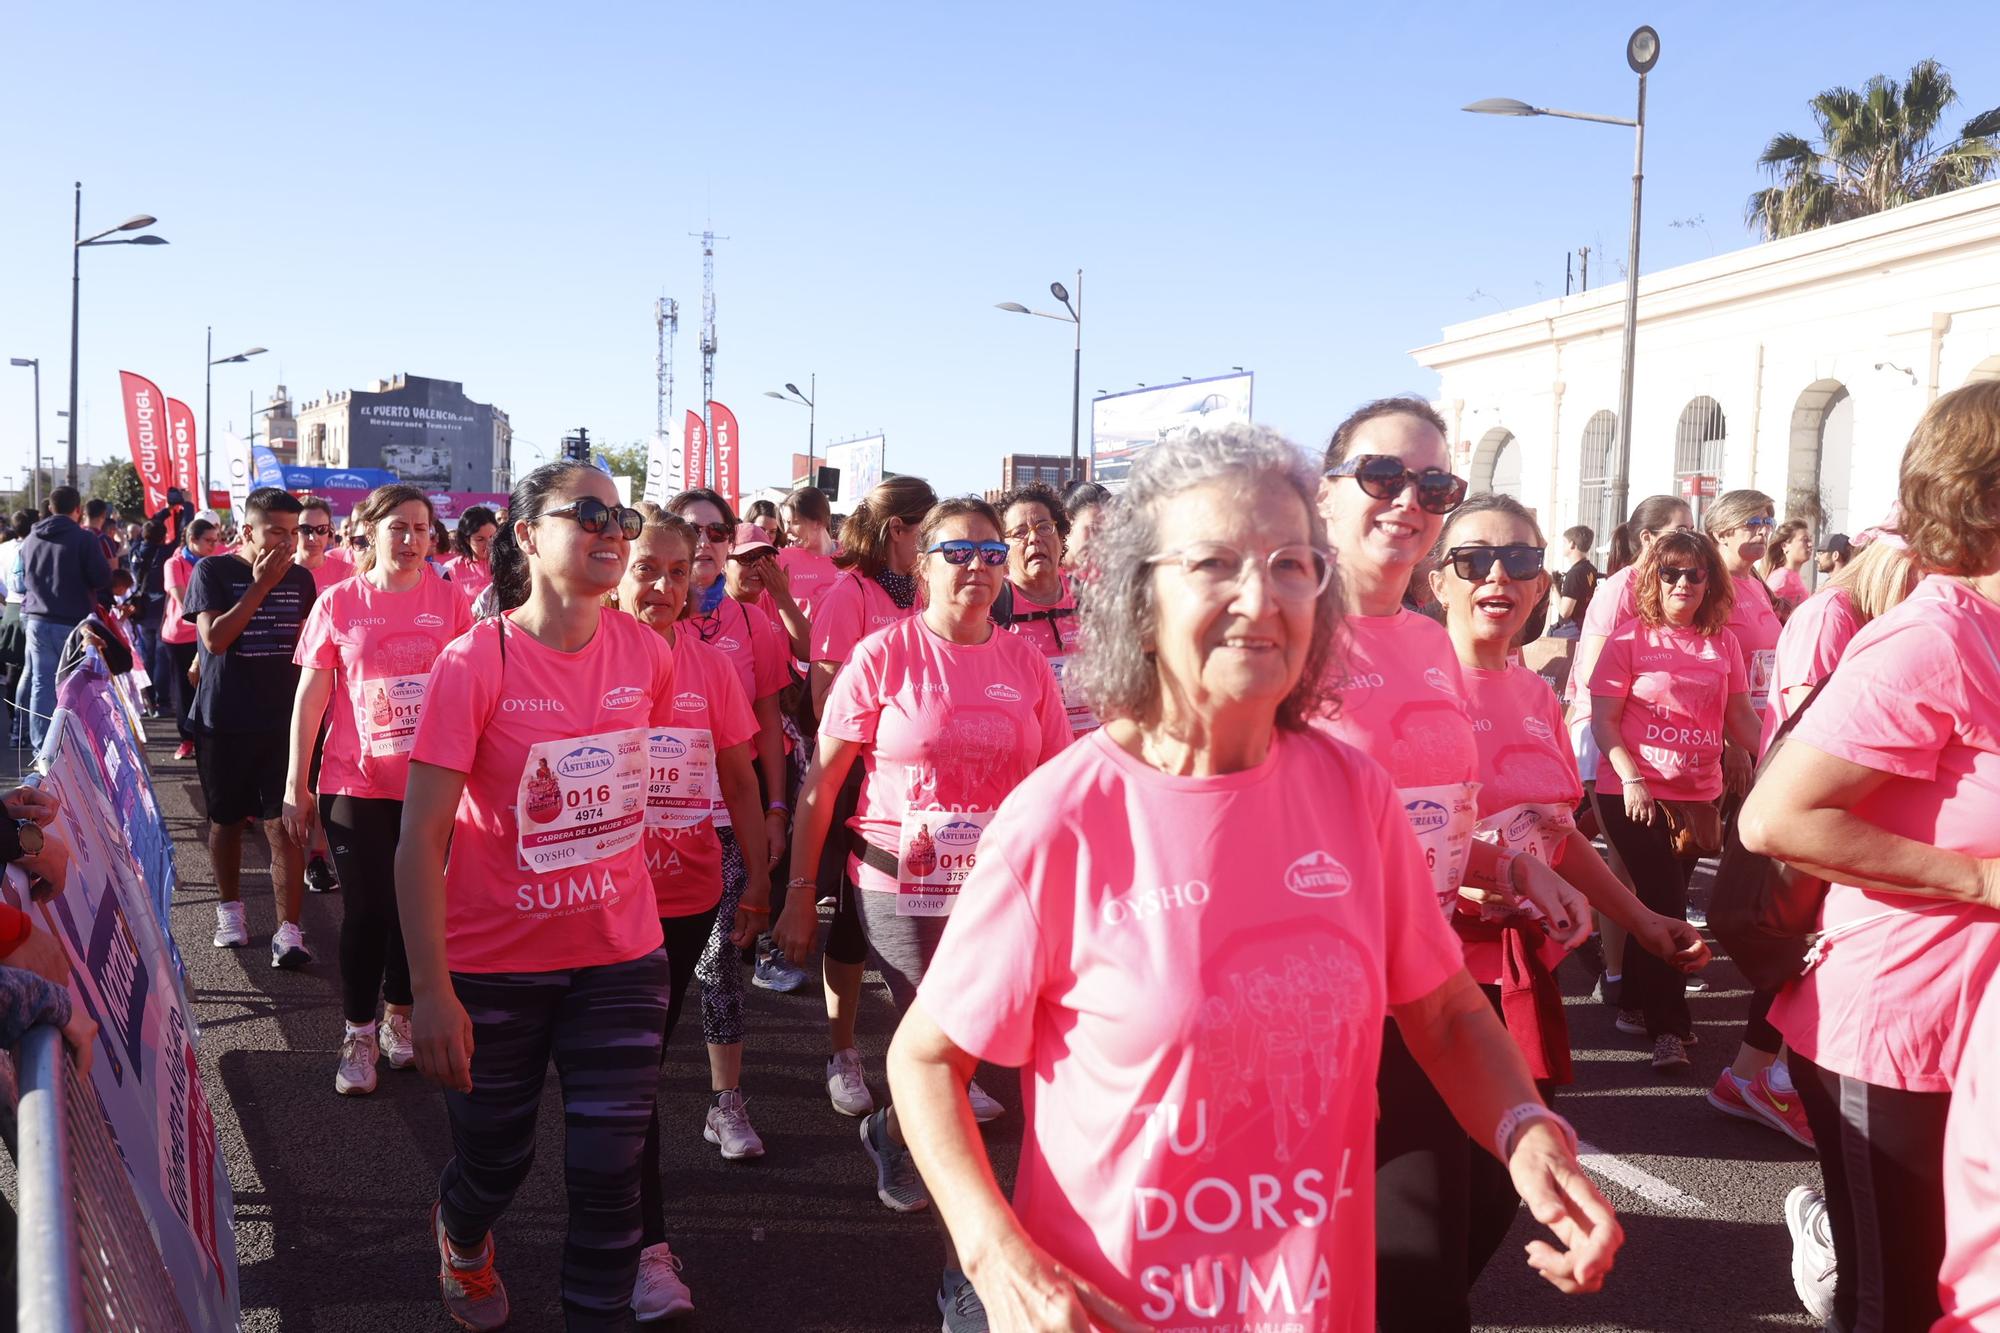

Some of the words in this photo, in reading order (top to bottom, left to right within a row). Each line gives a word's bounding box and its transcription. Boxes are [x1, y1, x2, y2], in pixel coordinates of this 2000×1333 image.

[361, 407, 371, 415] EL
[373, 406, 410, 418] PUERTO
[349, 617, 386, 626] OYSHO
[502, 699, 565, 712] OYSHO
[1646, 724, 1719, 746] DORSAL
[618, 745, 641, 755] SUMA
[649, 745, 683, 754] STURIANA
[1643, 746, 1699, 769] SUMA
[562, 758, 611, 773] ASTURIANA
[904, 765, 937, 791] TU
[566, 785, 611, 808] 016
[648, 784, 671, 794] 4975
[575, 807, 603, 822] 4974
[537, 829, 574, 843] CARRERA
[575, 827, 587, 836] DE
[588, 825, 598, 834] LA
[598, 820, 622, 832] MUJER
[605, 832, 636, 848] Santander
[534, 847, 576, 864] OYSHO
[644, 848, 681, 870] MA
[940, 853, 976, 868] 016
[515, 868, 618, 911] SUMA
[908, 900, 944, 909] OYSHO
[1103, 879, 1210, 926] OYSHO
[1132, 1098, 1207, 1161] TU
[1140, 1253, 1332, 1322] SUMA
